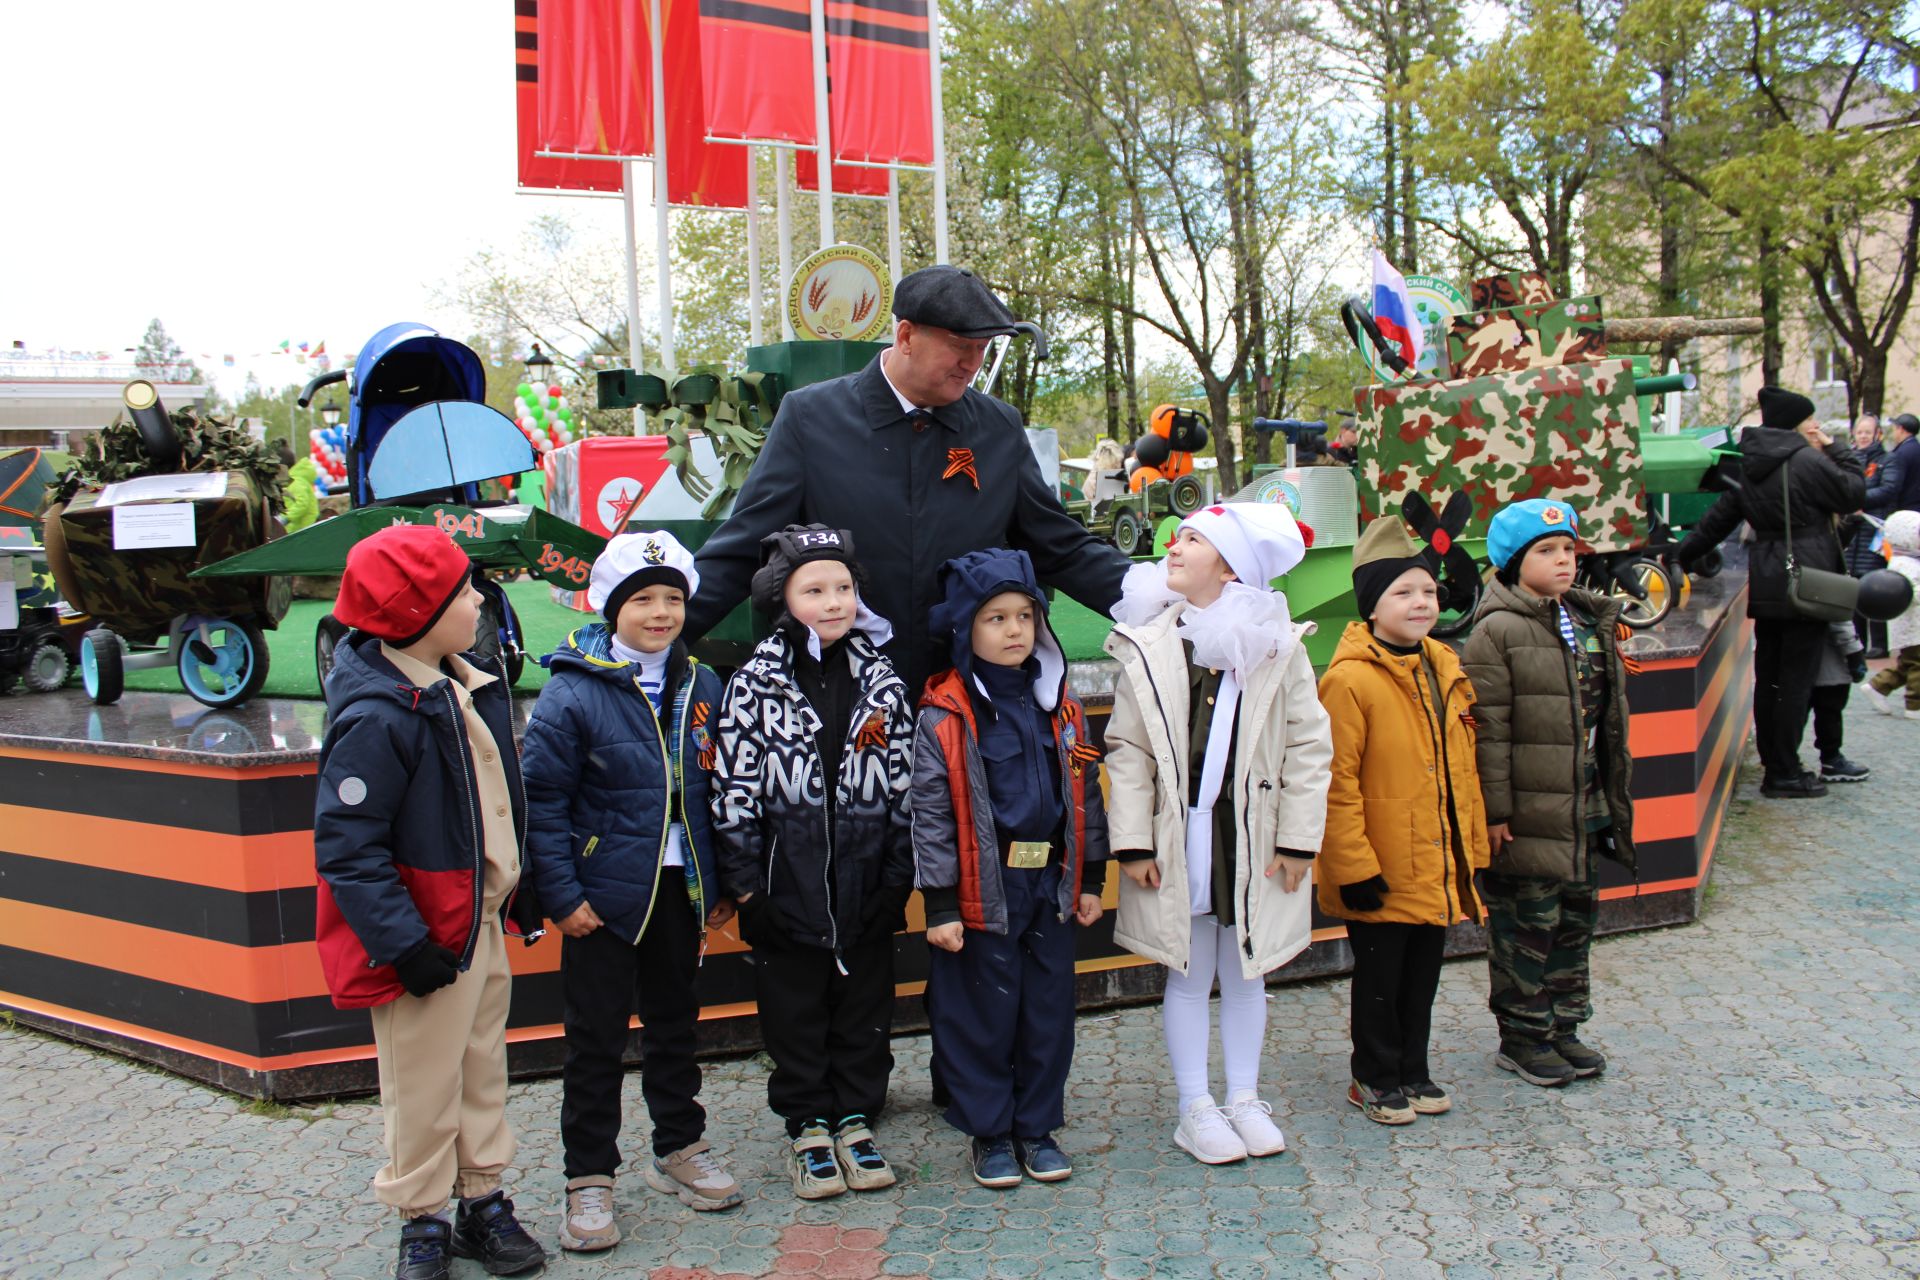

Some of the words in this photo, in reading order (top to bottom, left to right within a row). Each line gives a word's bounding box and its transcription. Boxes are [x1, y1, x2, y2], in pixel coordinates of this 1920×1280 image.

[789, 278, 802, 329] МБДОУ
[861, 254, 881, 273] сад
[1405, 278, 1434, 289] СКИЙ
[434, 509, 486, 539] 1941
[797, 532, 840, 546] Т-34
[537, 543, 592, 584] 1945
